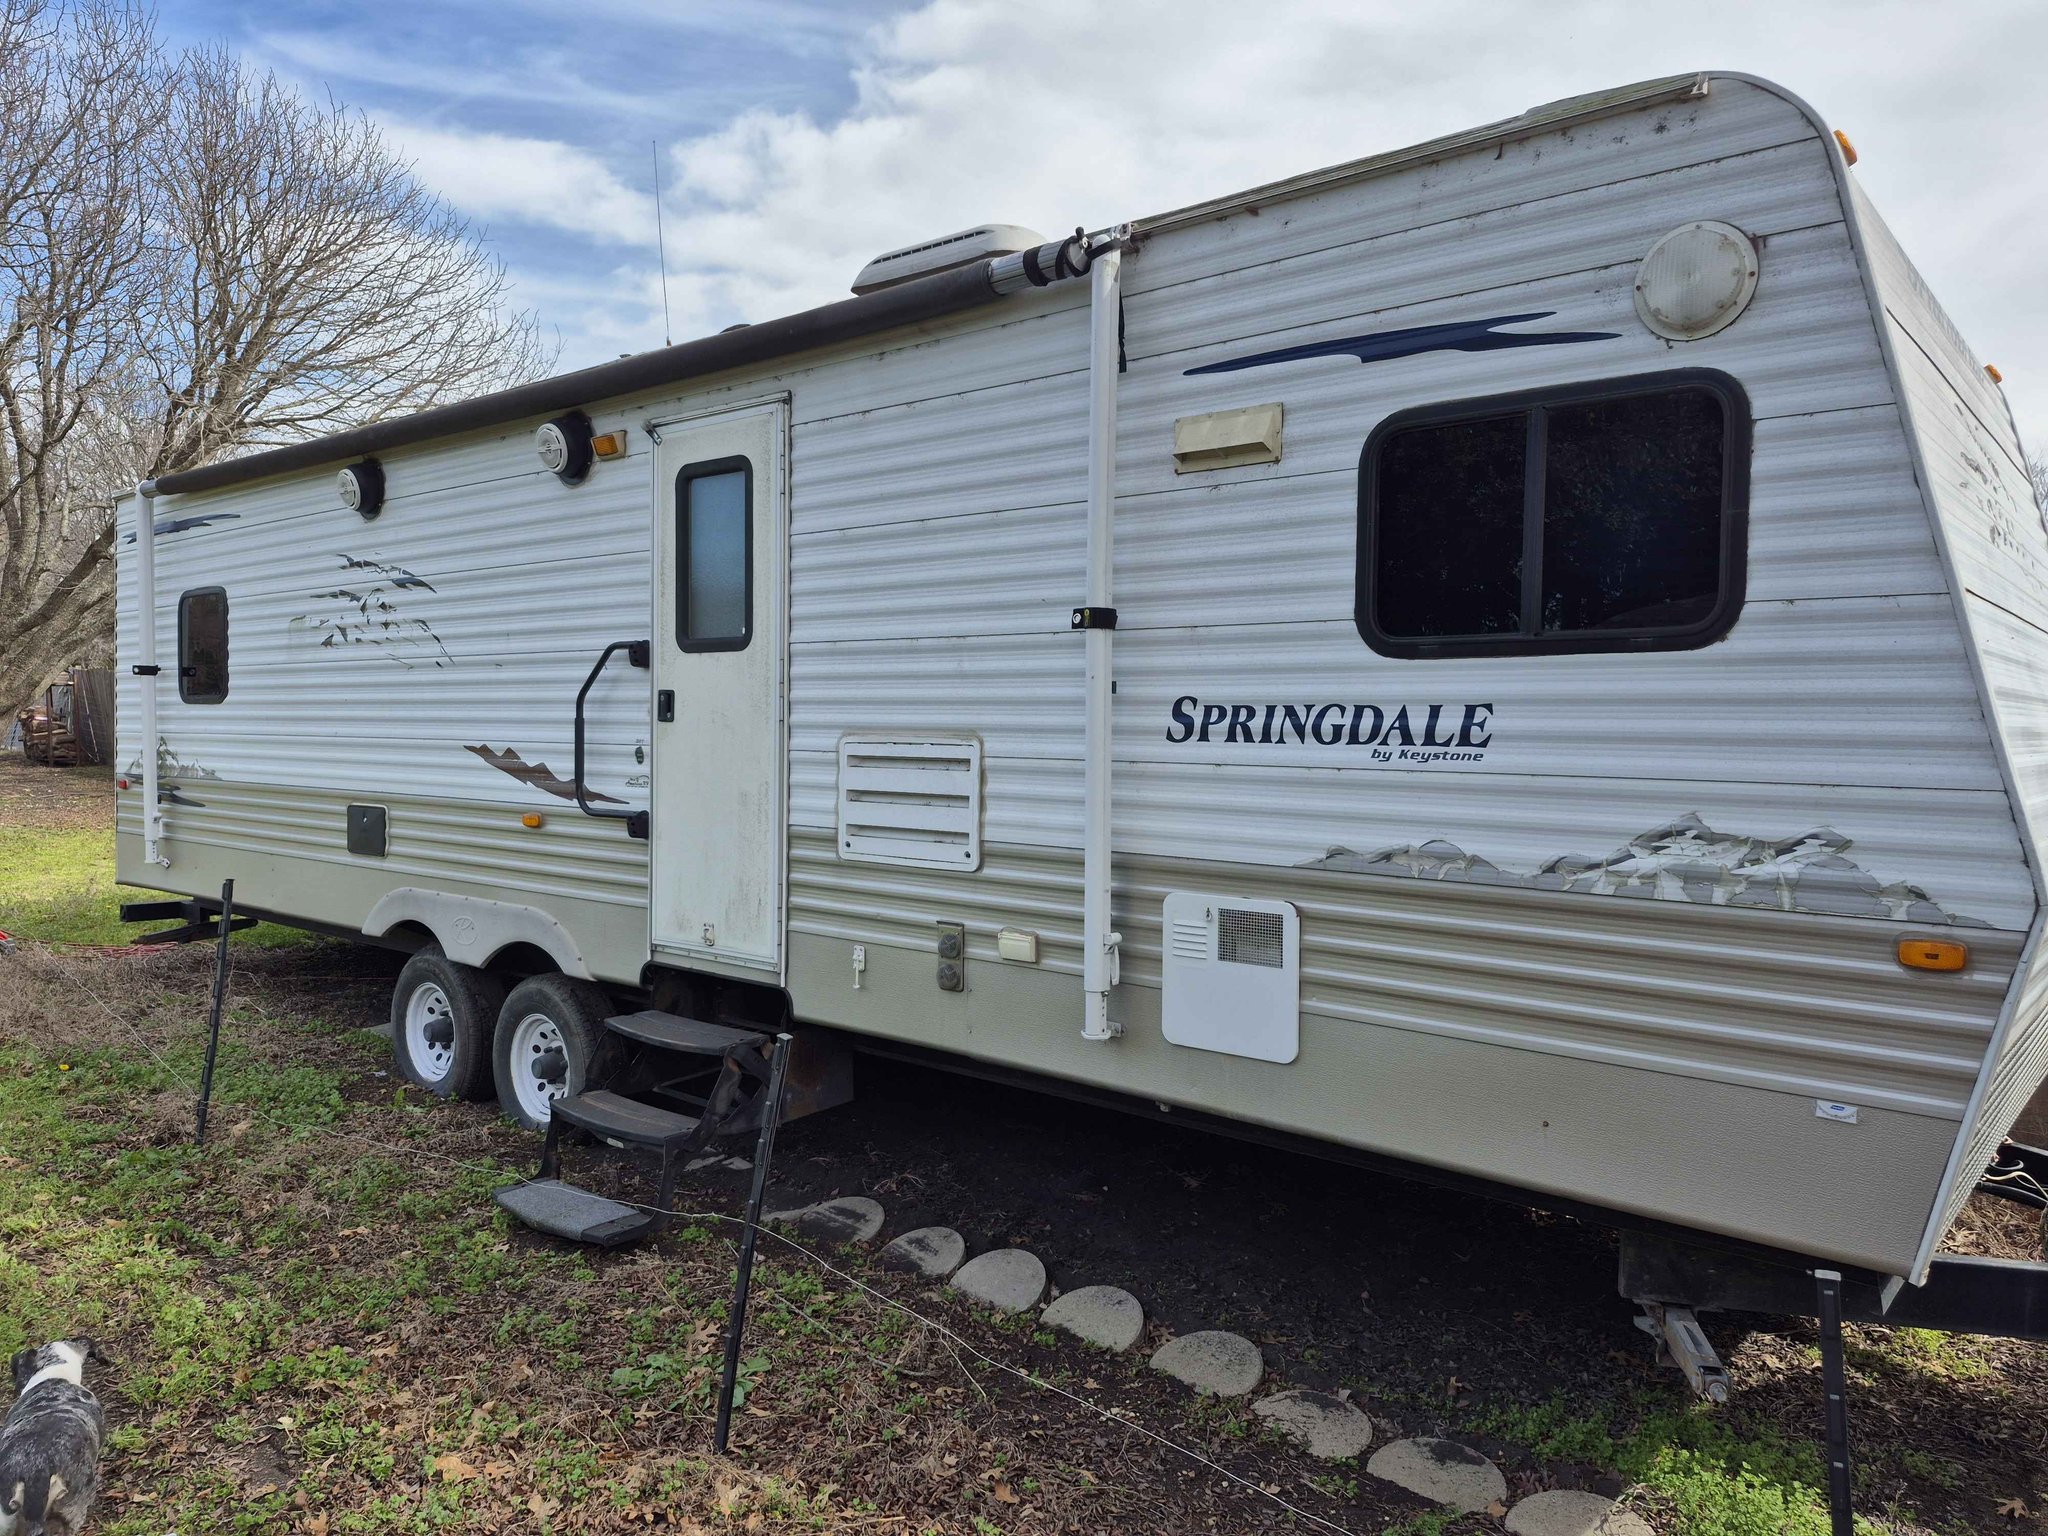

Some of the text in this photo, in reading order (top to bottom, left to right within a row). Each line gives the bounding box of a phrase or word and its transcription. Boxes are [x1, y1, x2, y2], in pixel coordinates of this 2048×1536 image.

[1166, 695, 1494, 748] SPRINGDALE
[1371, 749, 1484, 763] by Keystone
